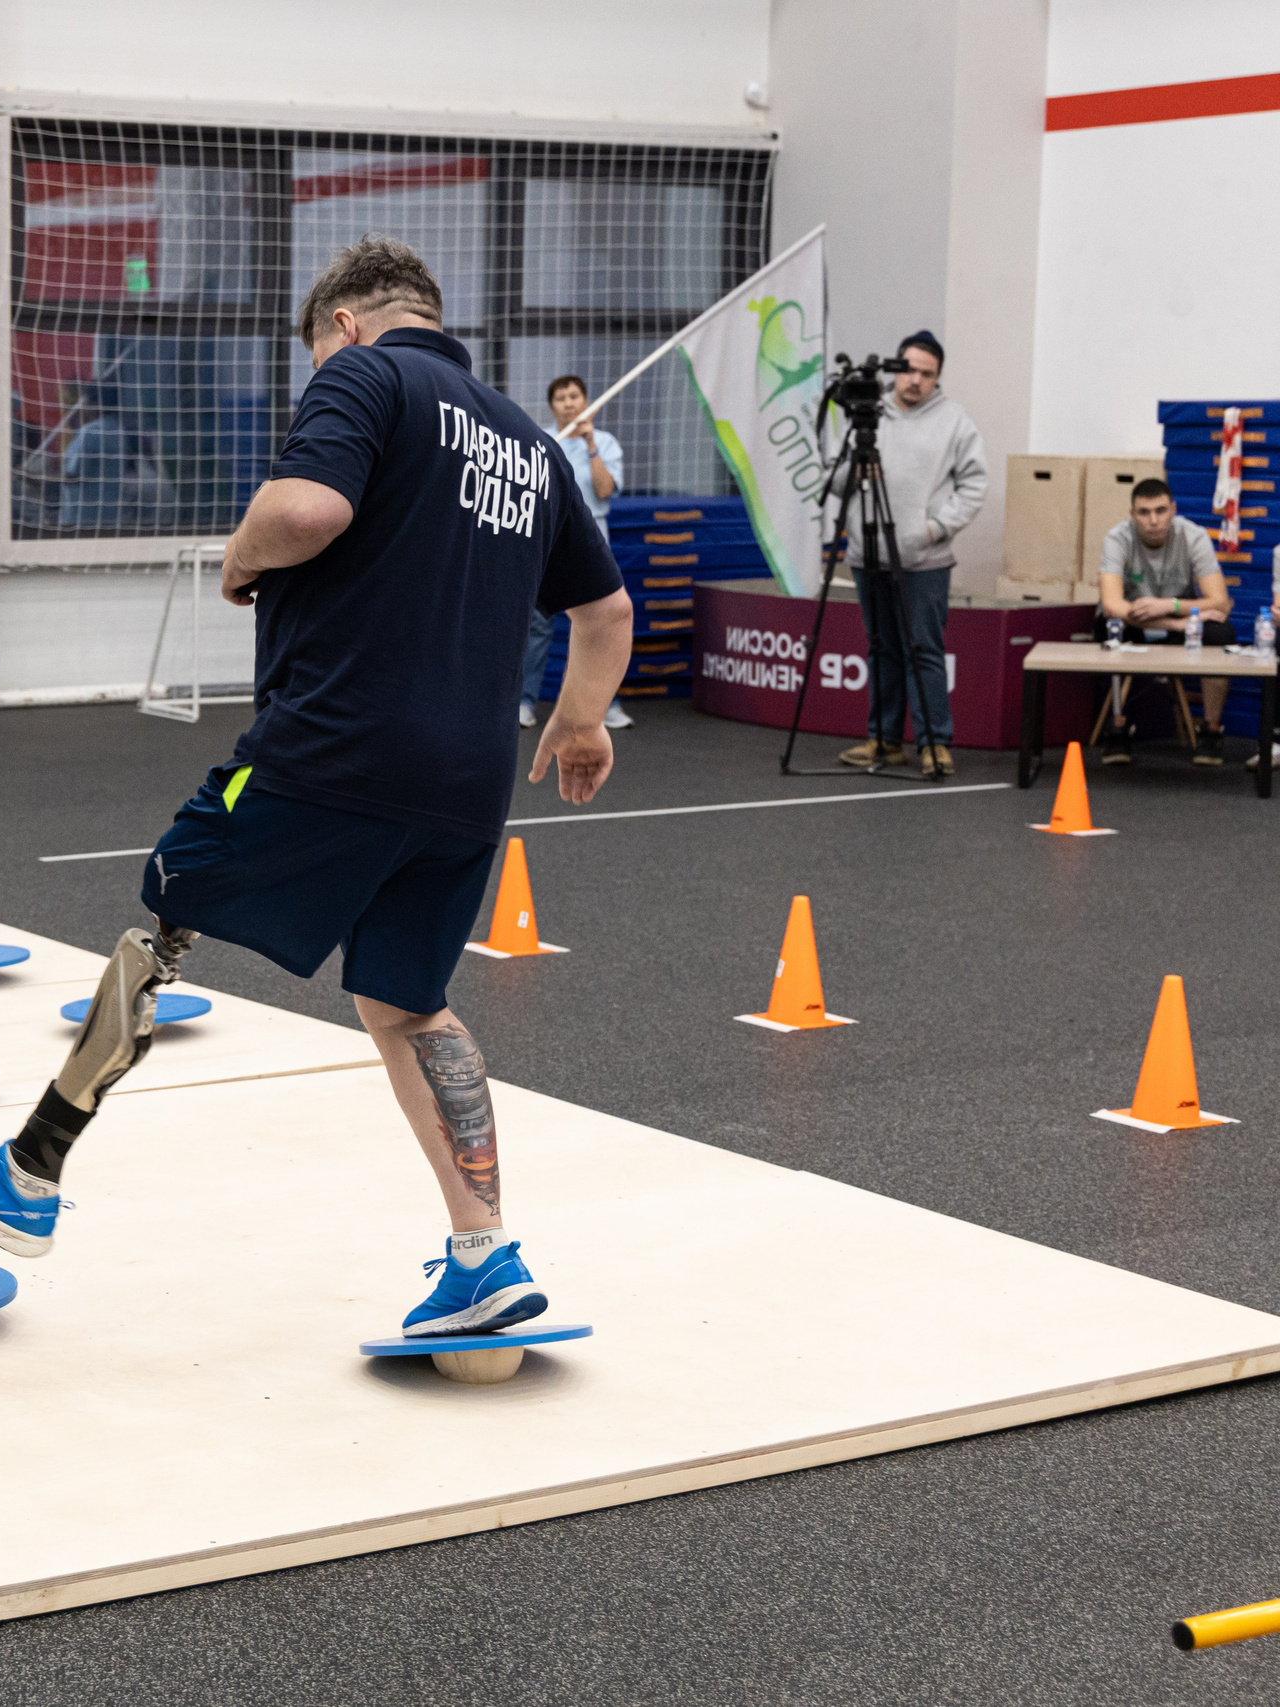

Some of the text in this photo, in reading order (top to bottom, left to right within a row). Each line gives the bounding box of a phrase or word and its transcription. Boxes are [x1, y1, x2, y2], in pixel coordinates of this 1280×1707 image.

[438, 400, 550, 501] ГЛАВНЫЙ
[459, 460, 537, 538] СУДЬЯ
[725, 626, 808, 661] РОССИИ
